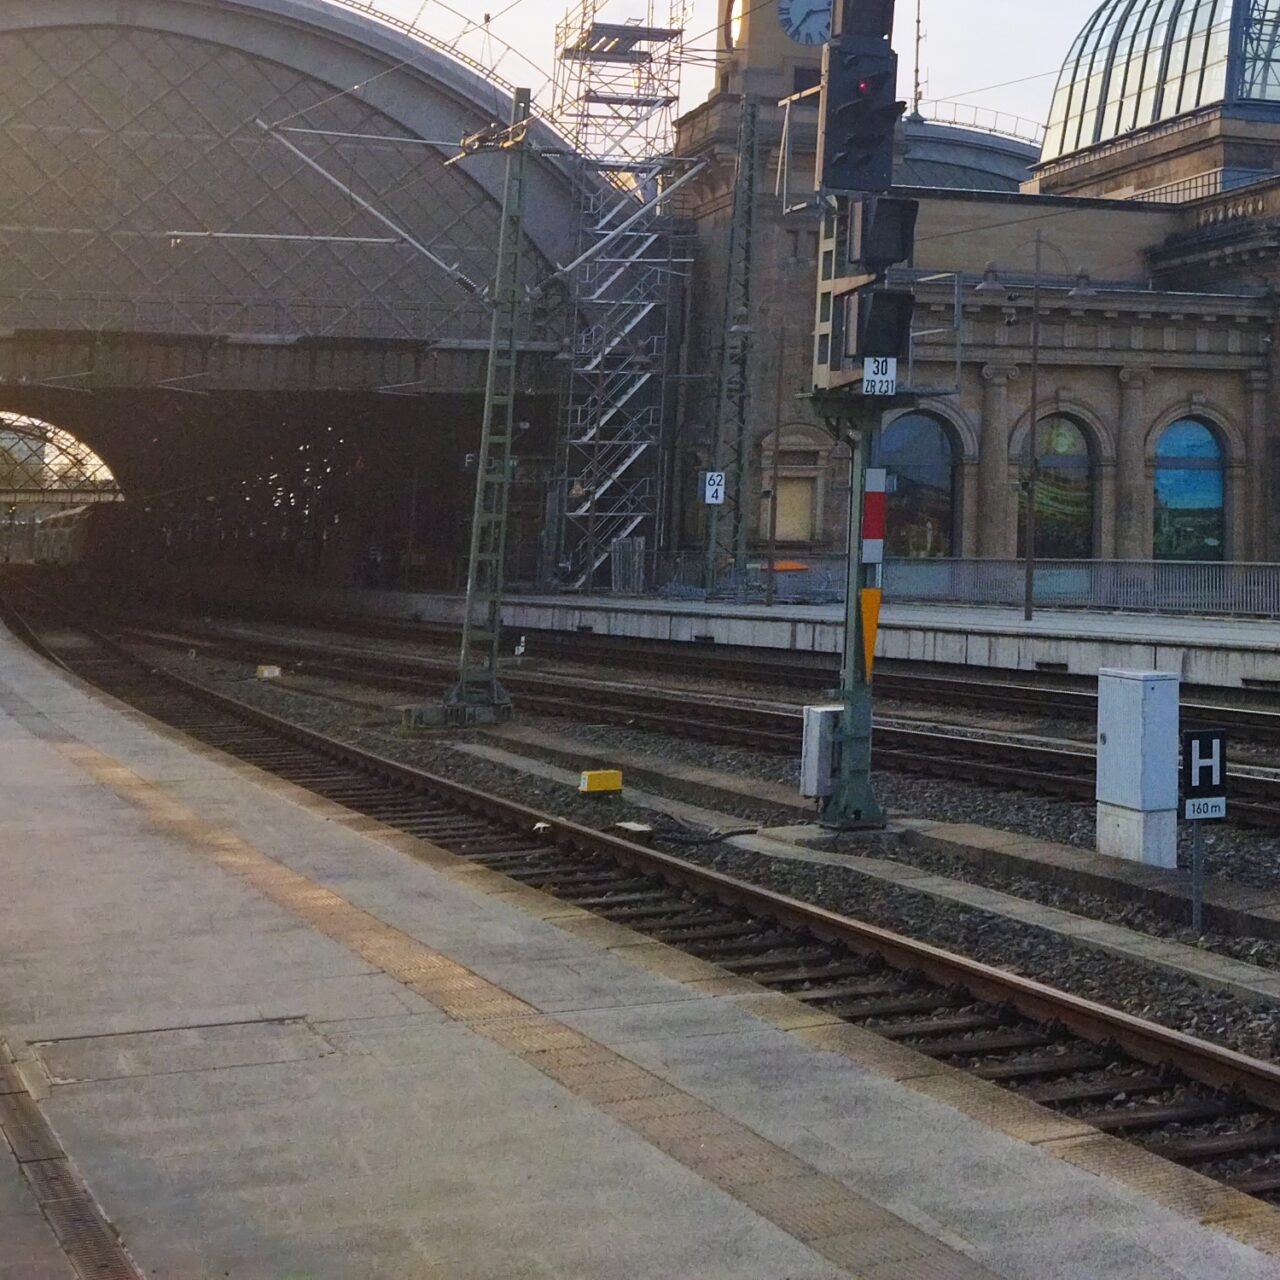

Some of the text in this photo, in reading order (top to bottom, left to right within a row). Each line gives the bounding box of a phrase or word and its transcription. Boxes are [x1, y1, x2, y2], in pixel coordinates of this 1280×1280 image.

[873, 358, 888, 375] 30
[865, 379, 894, 393] ZR 231
[708, 474, 723, 487] 62
[711, 488, 719, 501] 4
[1192, 739, 1220, 786] H
[1192, 803, 1221, 815] 160 m
